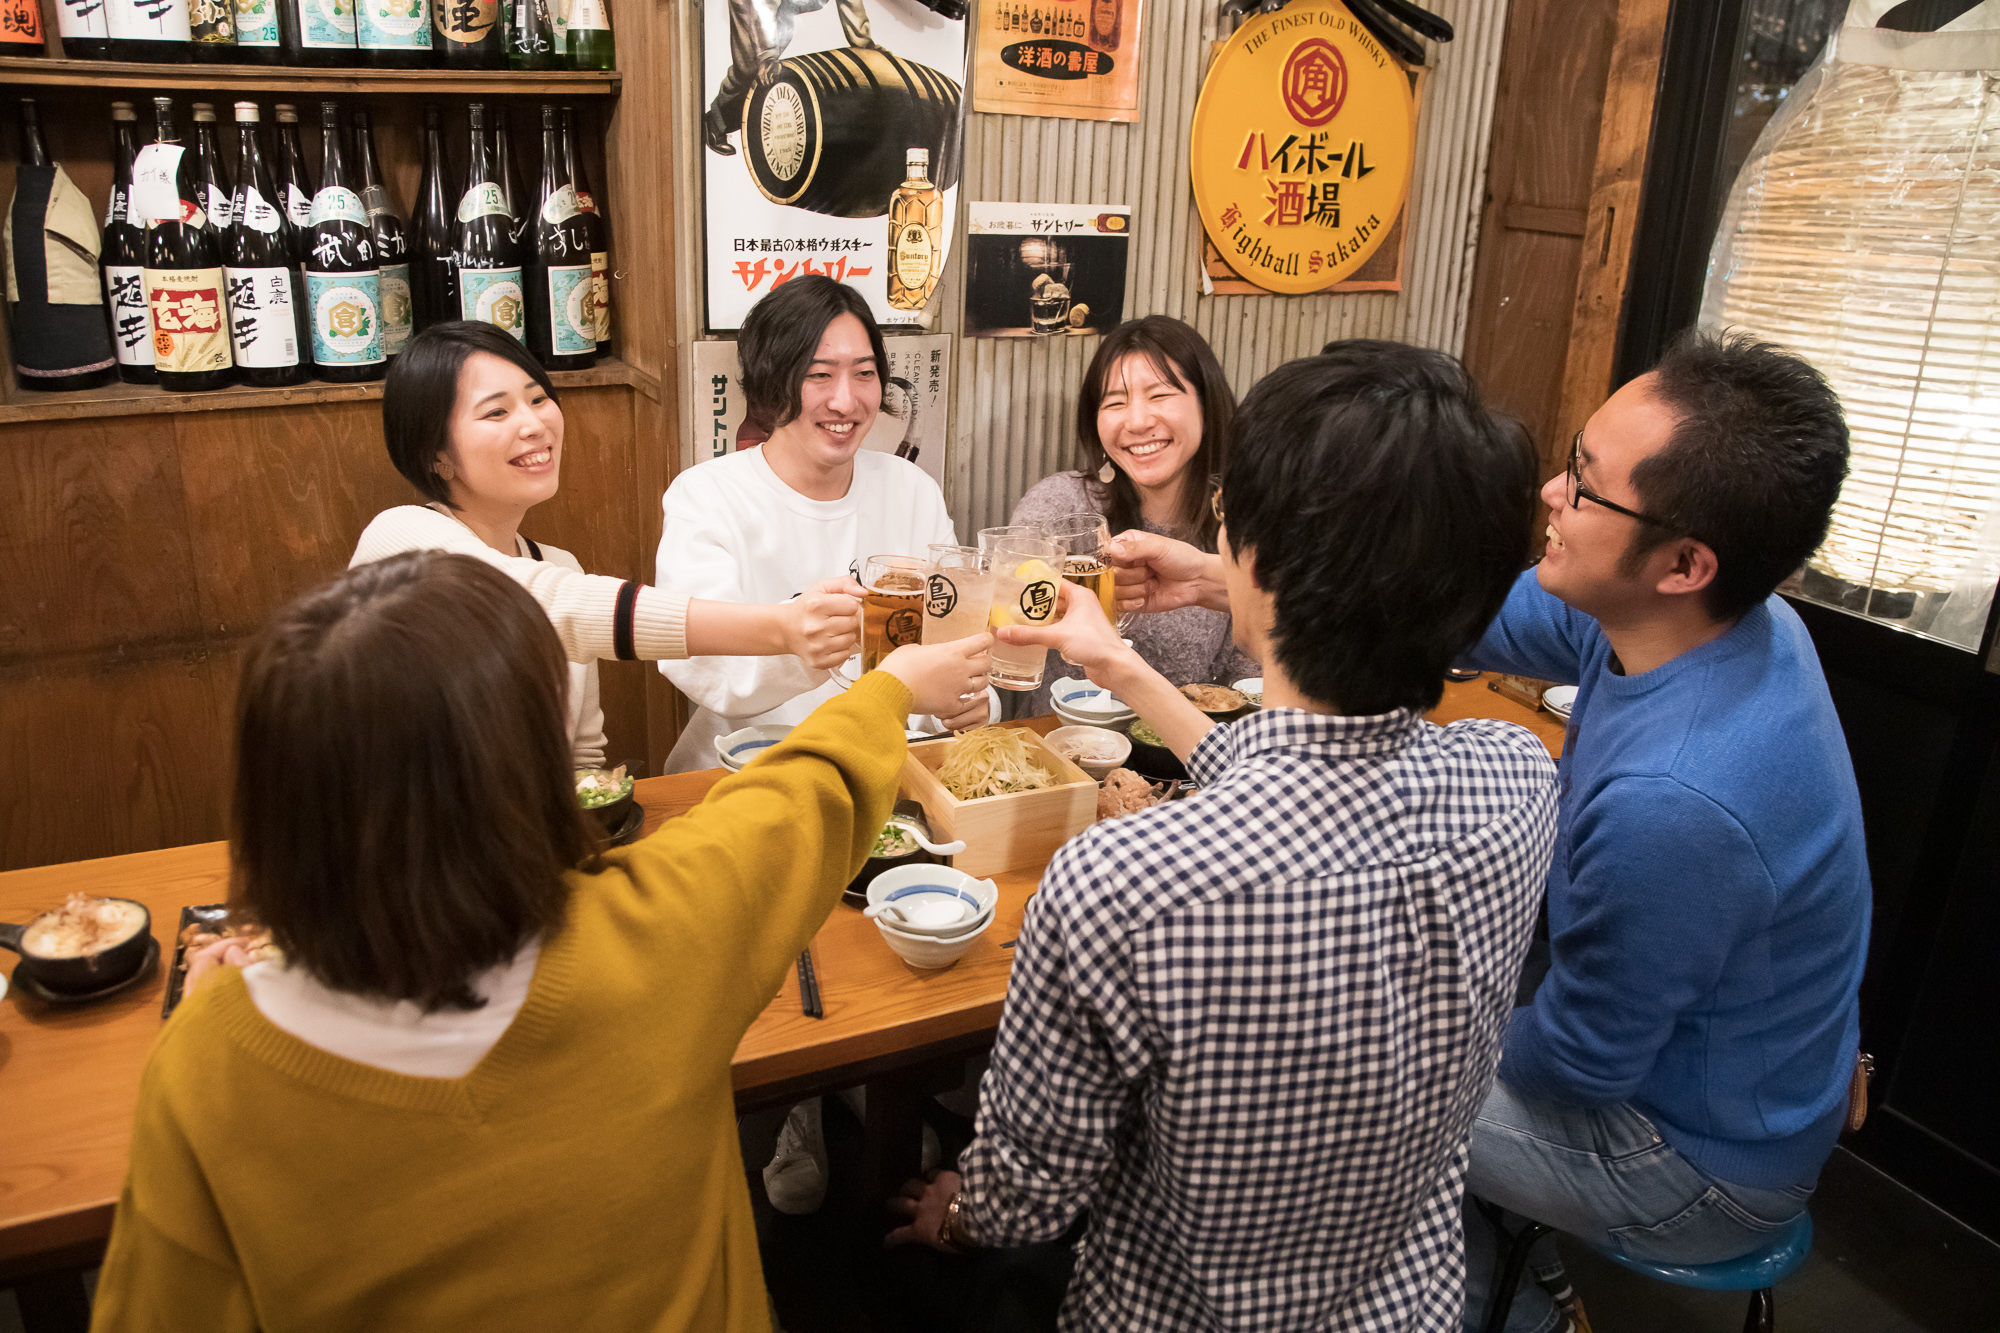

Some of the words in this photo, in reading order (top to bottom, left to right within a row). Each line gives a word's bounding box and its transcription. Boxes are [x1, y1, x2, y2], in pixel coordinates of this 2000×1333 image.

[262, 27, 277, 41] 25
[1242, 30, 1271, 56] THE
[1271, 12, 1315, 35] FINEST
[1319, 11, 1346, 31] OLD
[1348, 21, 1389, 70] WHISKY
[762, 93, 776, 142] WHISKY
[1236, 131, 1376, 180] ハイボール
[328, 194, 345, 210] 25
[483, 190, 499, 205] 25
[1262, 177, 1341, 229] 酒場
[1030, 219, 1085, 233] サントリー
[1219, 202, 1300, 276] Highball
[1307, 213, 1381, 275] Sakaba
[269, 275, 289, 305] 白鹿
[732, 255, 873, 292] サントリー
[366, 346, 378, 360] 25
